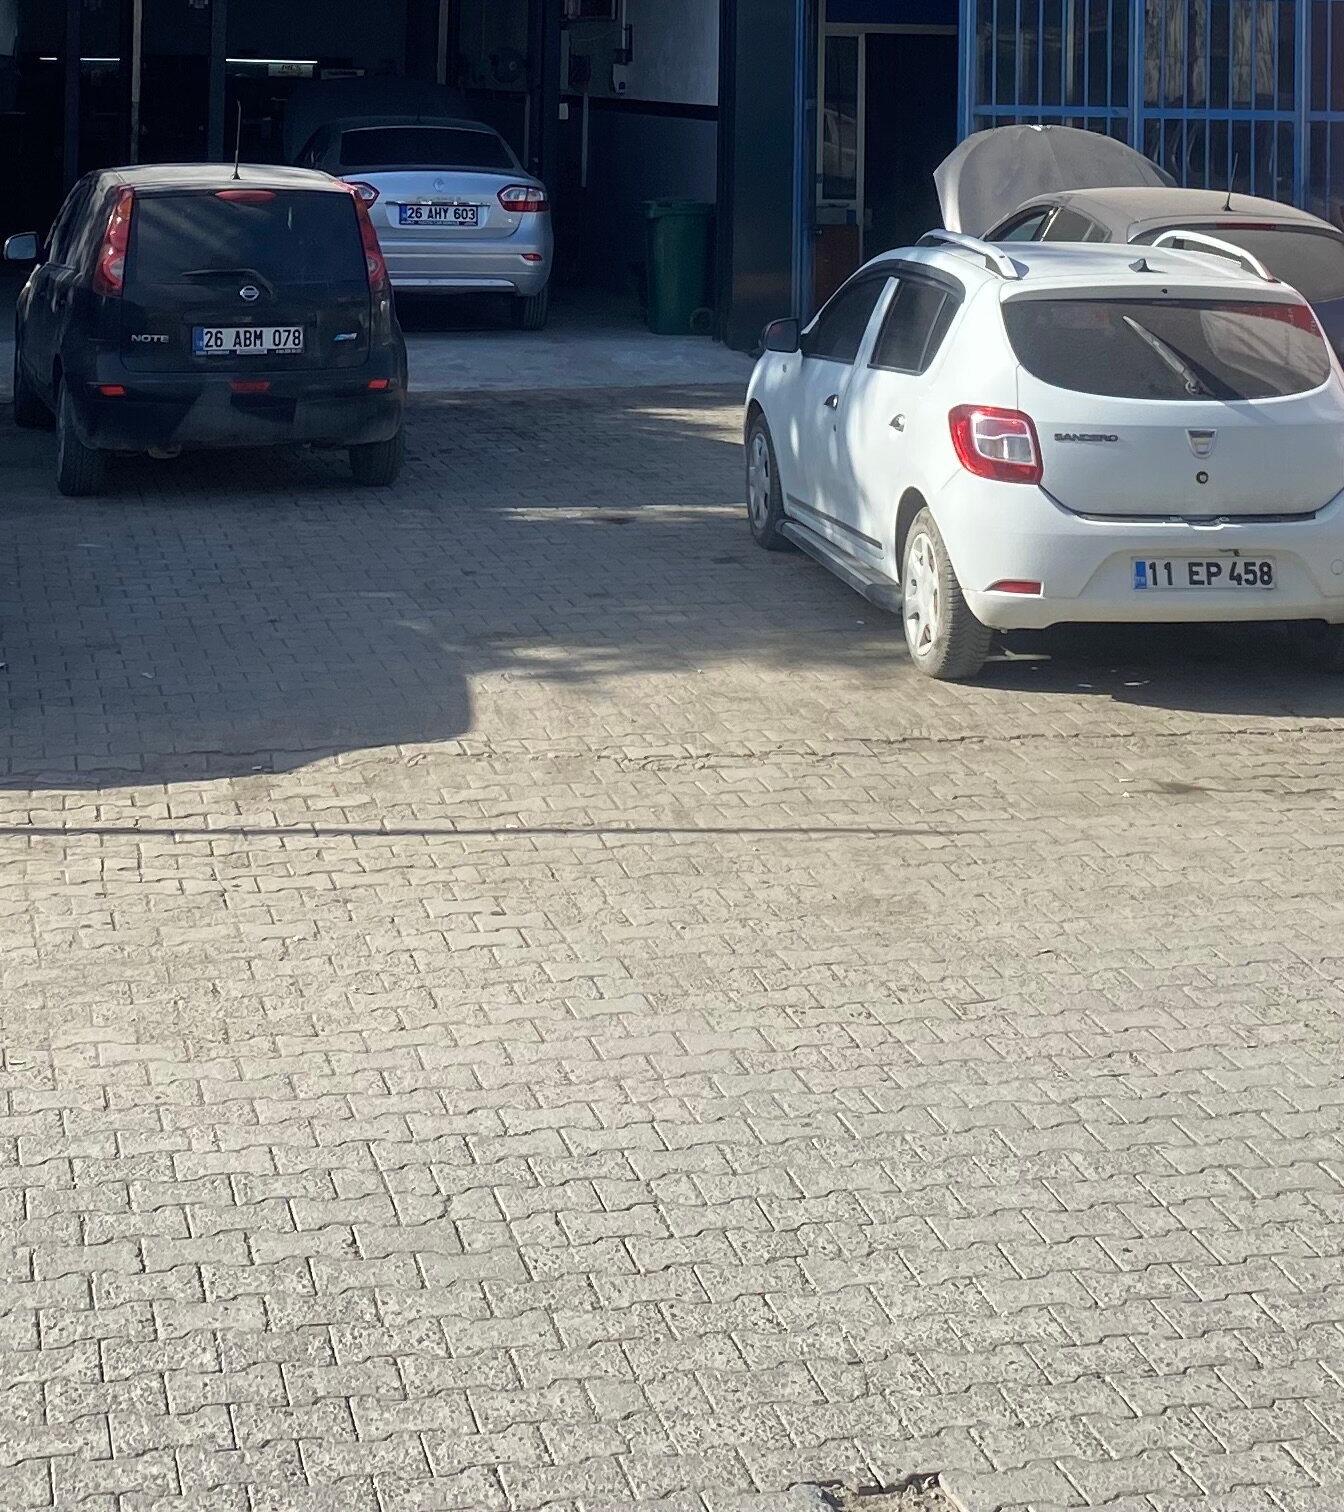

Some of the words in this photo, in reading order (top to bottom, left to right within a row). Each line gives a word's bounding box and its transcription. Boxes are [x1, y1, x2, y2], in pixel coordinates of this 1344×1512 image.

[407, 207, 422, 219] 26
[427, 207, 449, 219] AHY
[453, 208, 475, 220] 603
[131, 334, 169, 343] NOTE
[204, 330, 223, 348] 26
[233, 330, 264, 348] ABM
[272, 329, 302, 347] 078
[1054, 433, 1118, 442] SANDERO
[1149, 561, 1173, 586] 11
[1187, 561, 1222, 586] EP
[1228, 561, 1273, 586] 458
